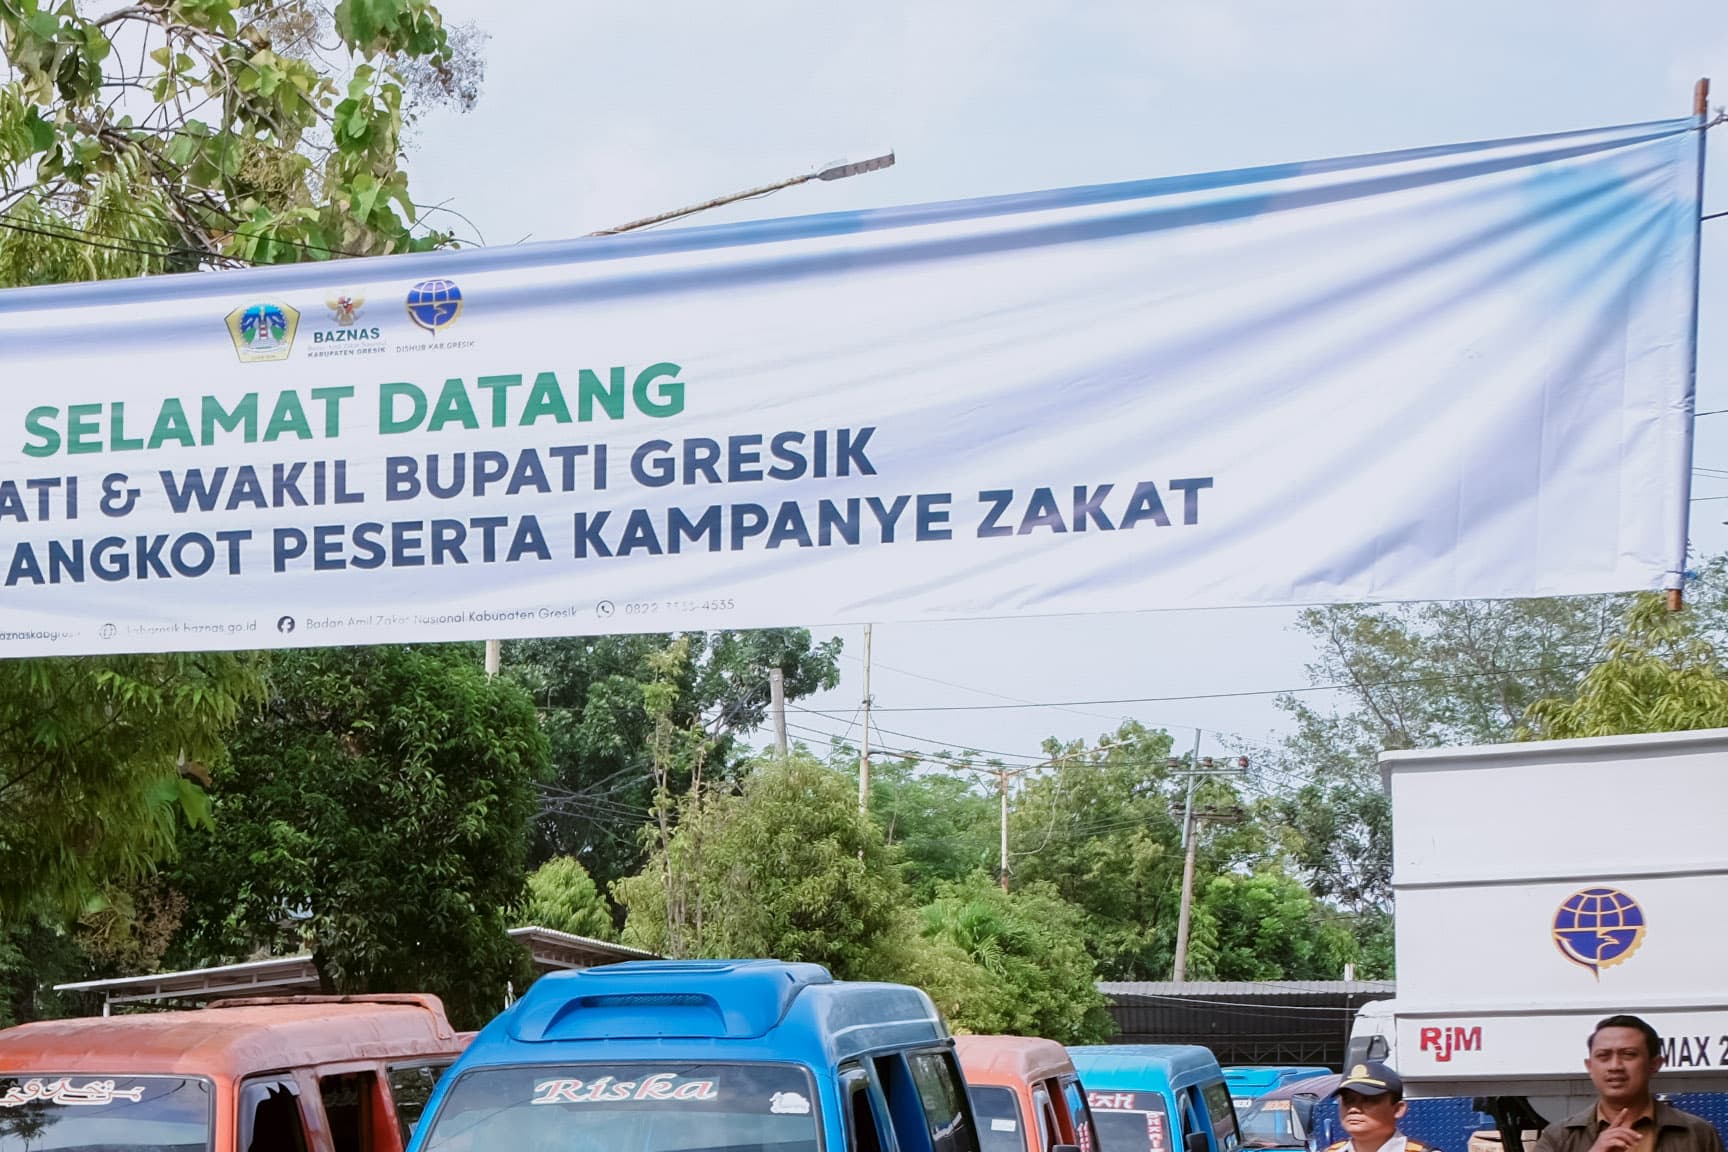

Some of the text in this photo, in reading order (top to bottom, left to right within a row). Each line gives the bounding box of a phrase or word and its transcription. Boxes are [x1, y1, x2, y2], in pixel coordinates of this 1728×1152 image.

[313, 327, 381, 344] BAZNAS
[22, 362, 686, 458] SELAMAT DATANG
[99, 472, 141, 518] &
[159, 460, 365, 514] WAKIL
[386, 443, 608, 502] BUPATI
[630, 427, 878, 488] GRESIK
[4, 529, 253, 587] ANGKOT
[273, 514, 553, 573] PESERTA
[574, 492, 953, 559] KAMPANYE
[977, 476, 1214, 538] ZAKAT
[305, 616, 344, 631] Badan
[468, 608, 535, 623] Kabupaten
[537, 606, 578, 619] Gresik
[530, 1072, 720, 1105] Riska
